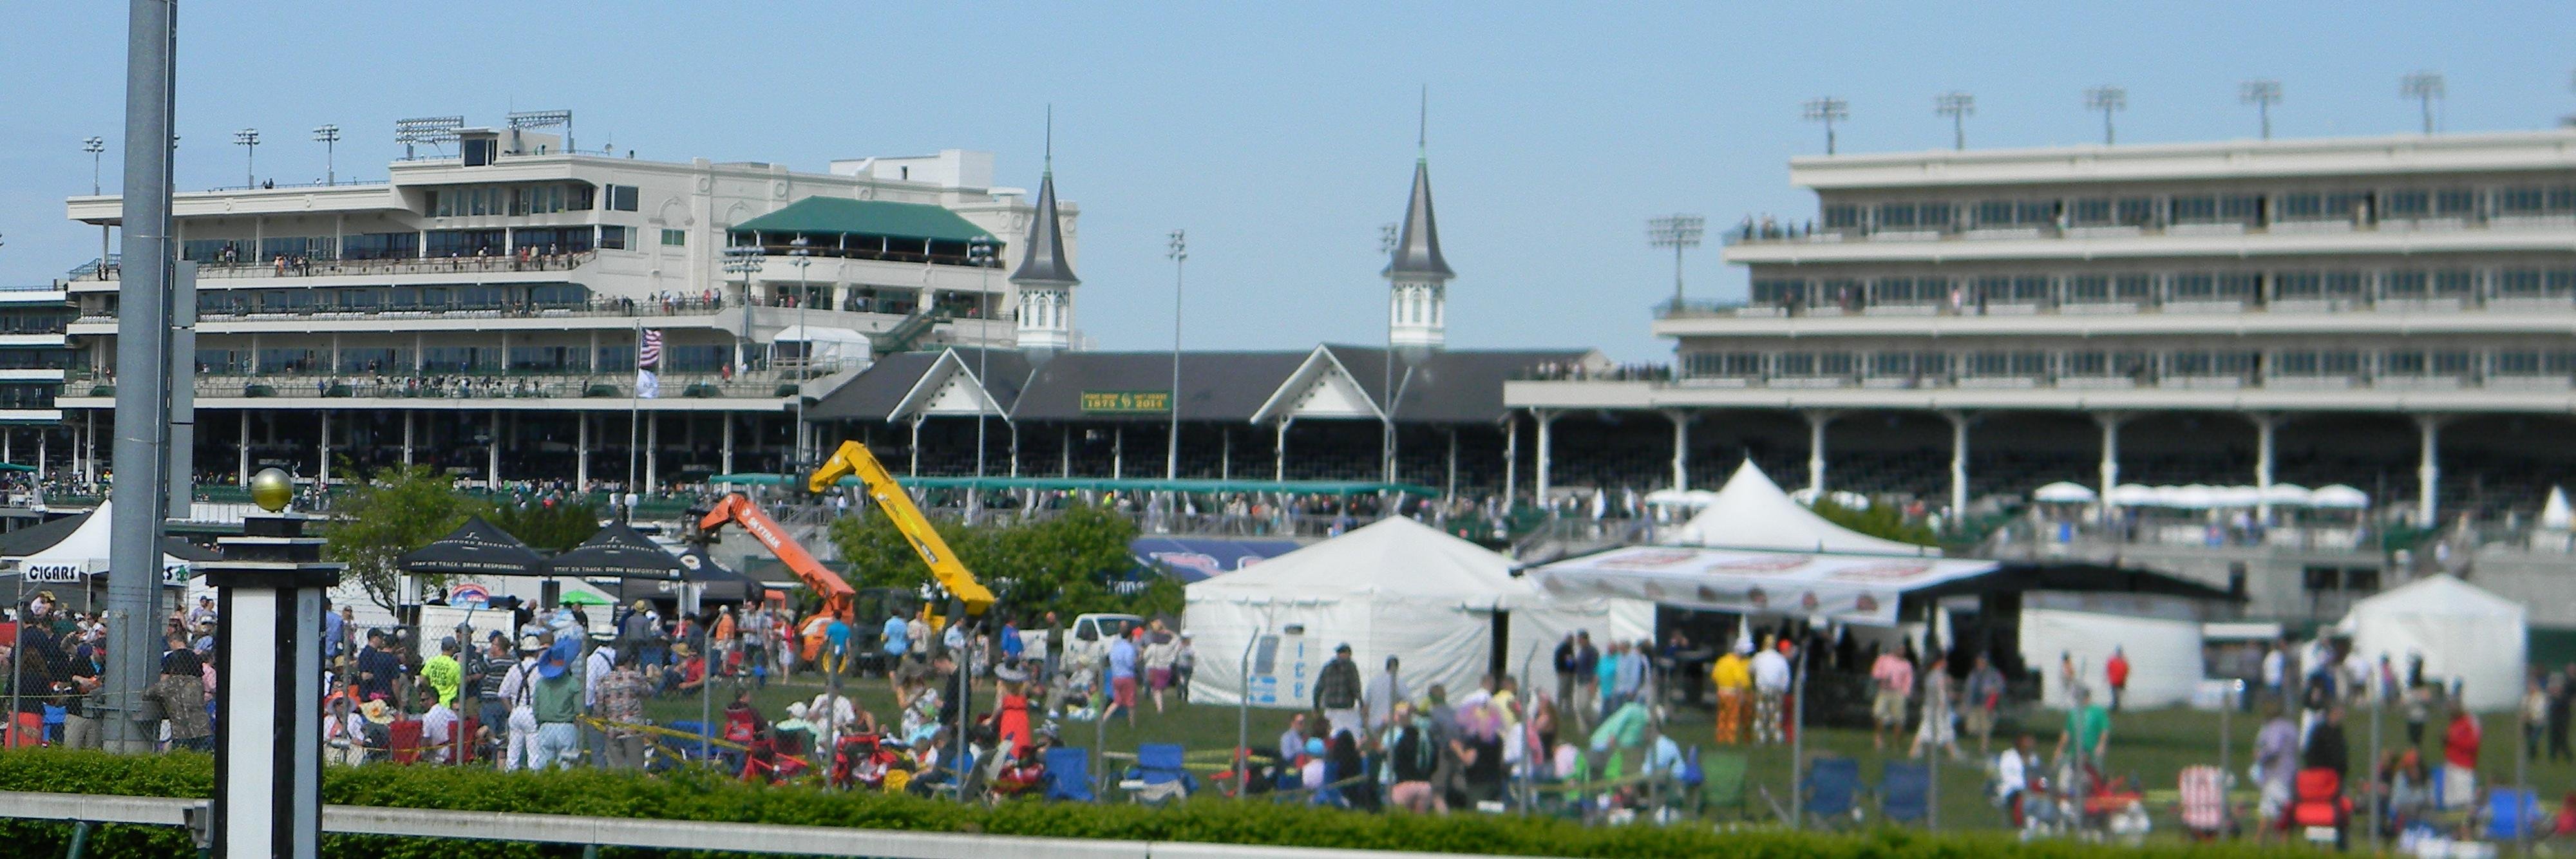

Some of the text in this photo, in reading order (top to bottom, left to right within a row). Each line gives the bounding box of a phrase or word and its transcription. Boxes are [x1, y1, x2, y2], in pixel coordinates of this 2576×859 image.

[1136, 399, 1162, 408] 2014
[748, 516, 781, 549] SKYTRAK
[29, 565, 77, 580] CIGARS
[1293, 641, 1305, 699] ICE
